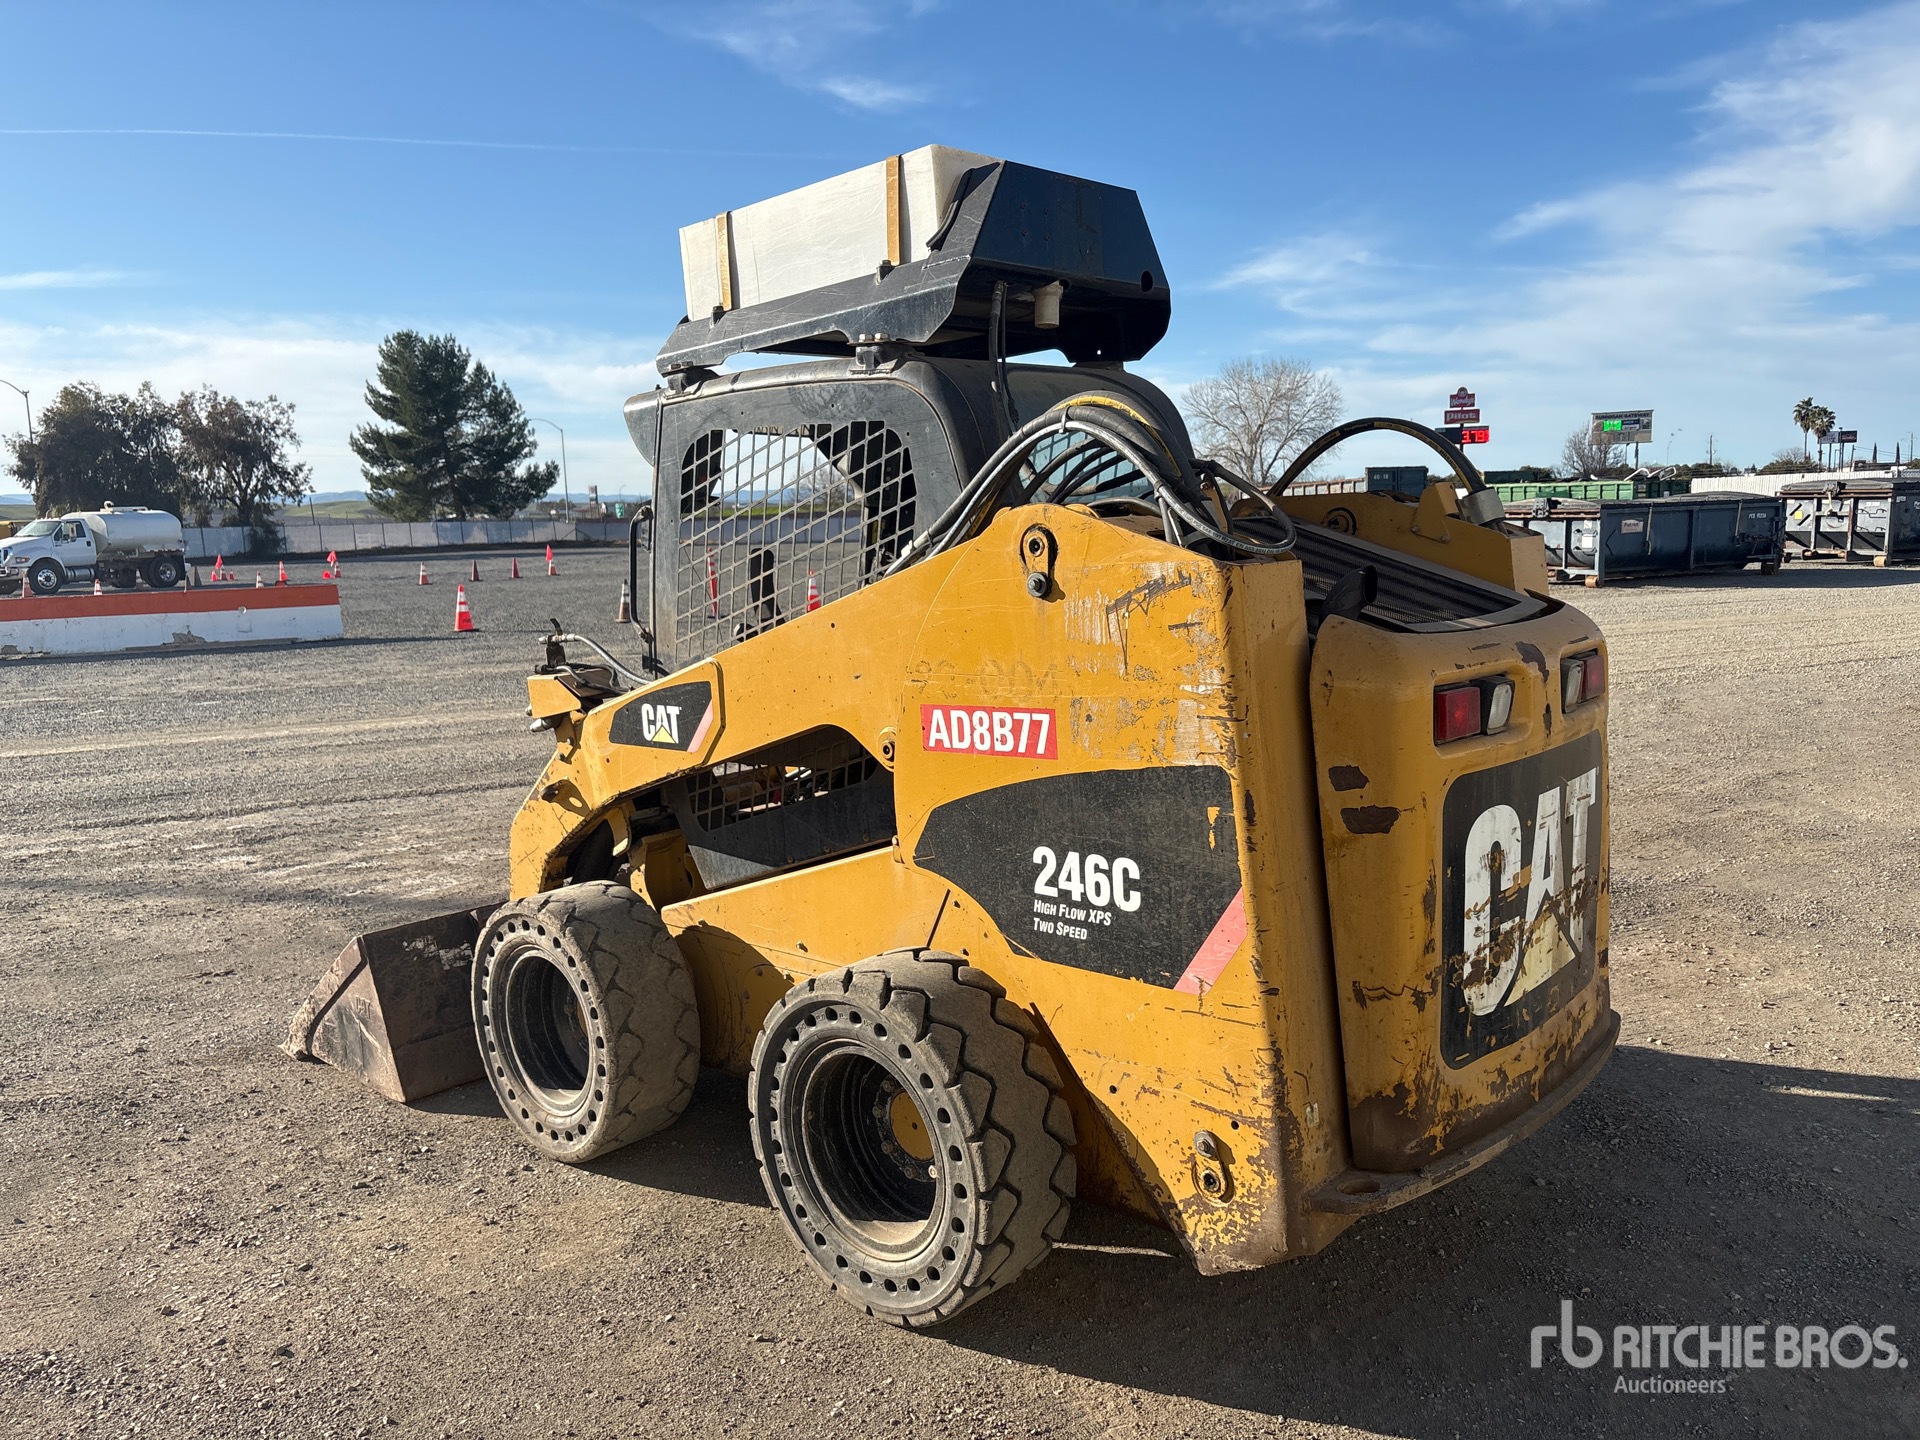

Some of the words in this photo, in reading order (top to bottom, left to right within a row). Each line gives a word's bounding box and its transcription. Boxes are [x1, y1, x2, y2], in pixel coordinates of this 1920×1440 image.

[641, 703, 681, 744] CAT
[928, 709, 1050, 754] AD8B77
[1033, 846, 1142, 912] 246C
[1463, 767, 1597, 1017] CAT
[1088, 909, 1112, 926] XPS
